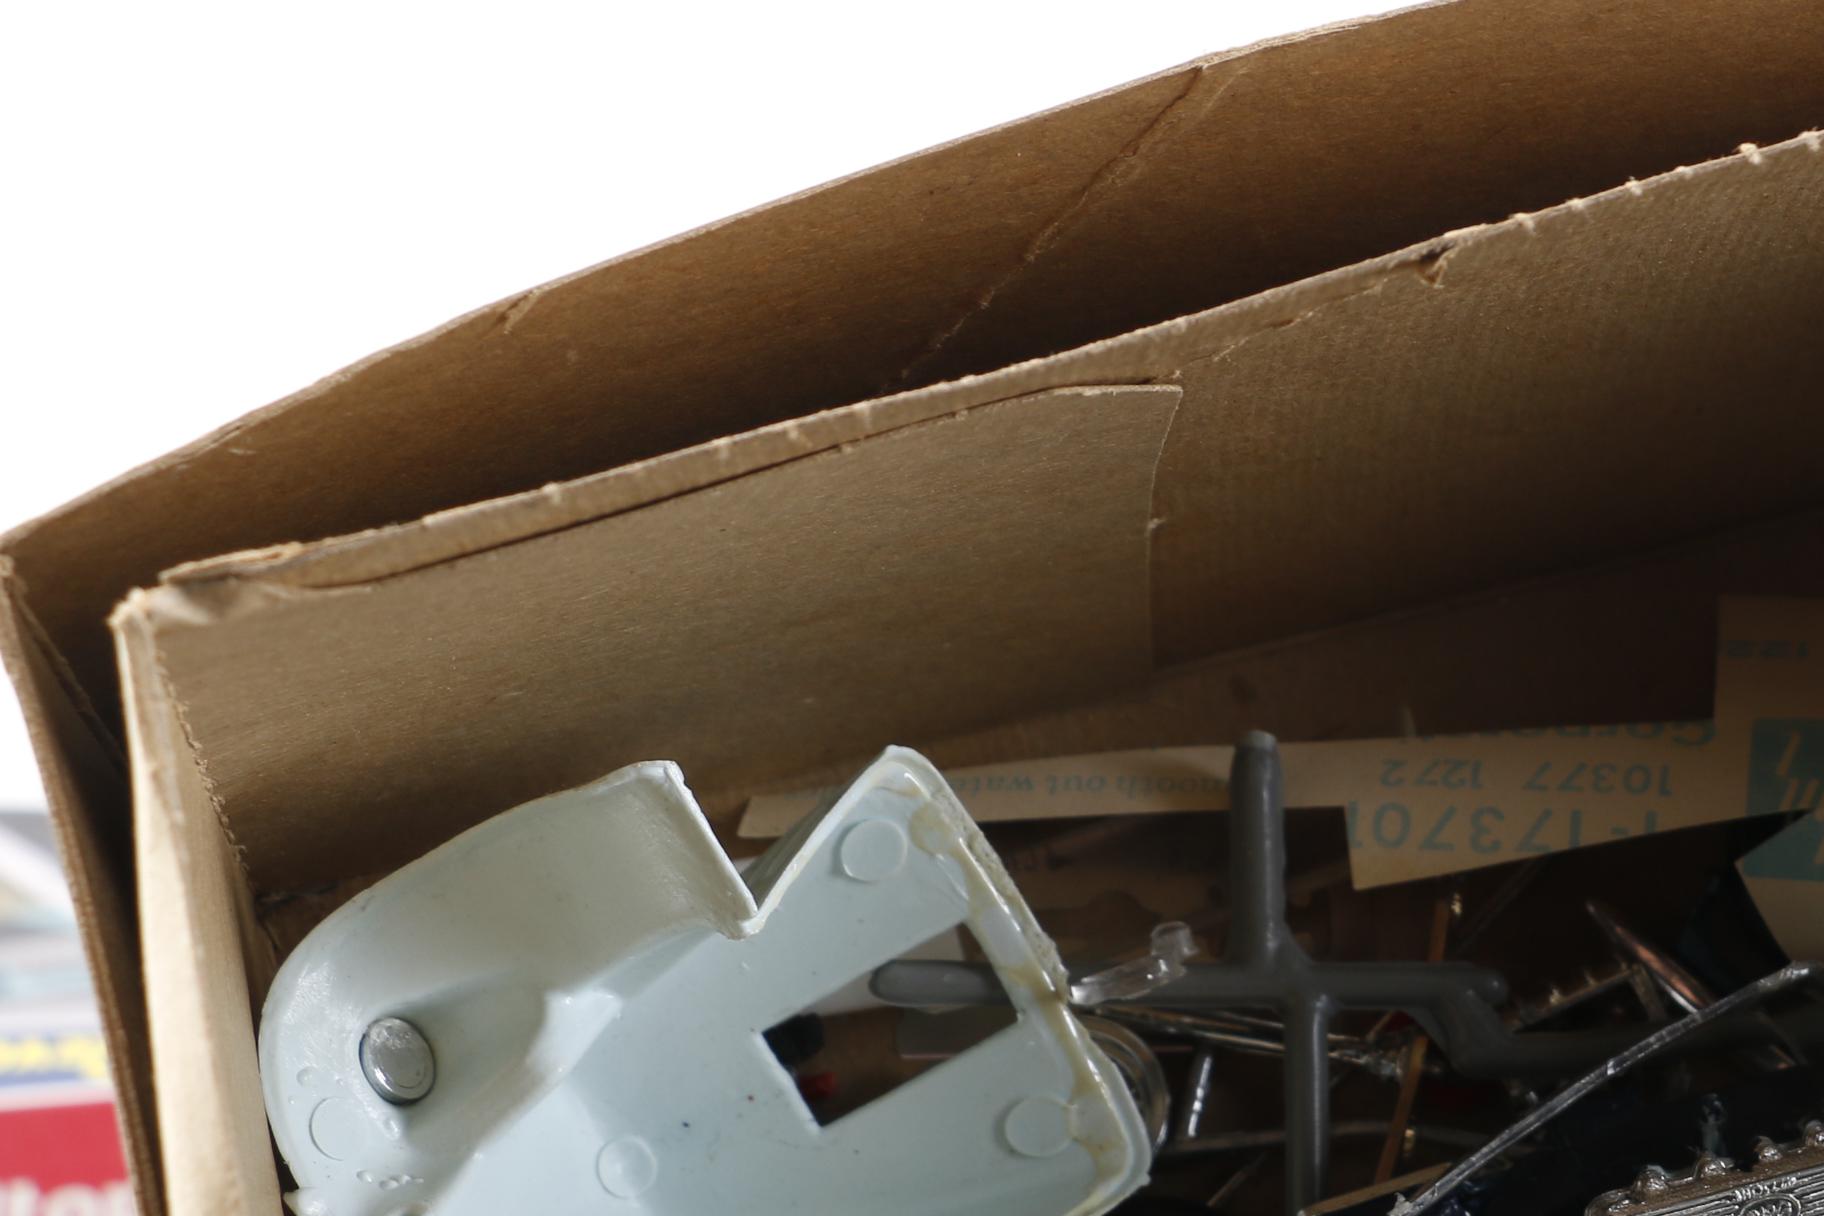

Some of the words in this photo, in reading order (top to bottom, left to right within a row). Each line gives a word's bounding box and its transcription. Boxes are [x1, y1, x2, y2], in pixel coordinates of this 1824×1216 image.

[1045, 775, 1107, 796] out
[1379, 757, 1484, 791] 1272
[1521, 761, 1673, 797] 10377
